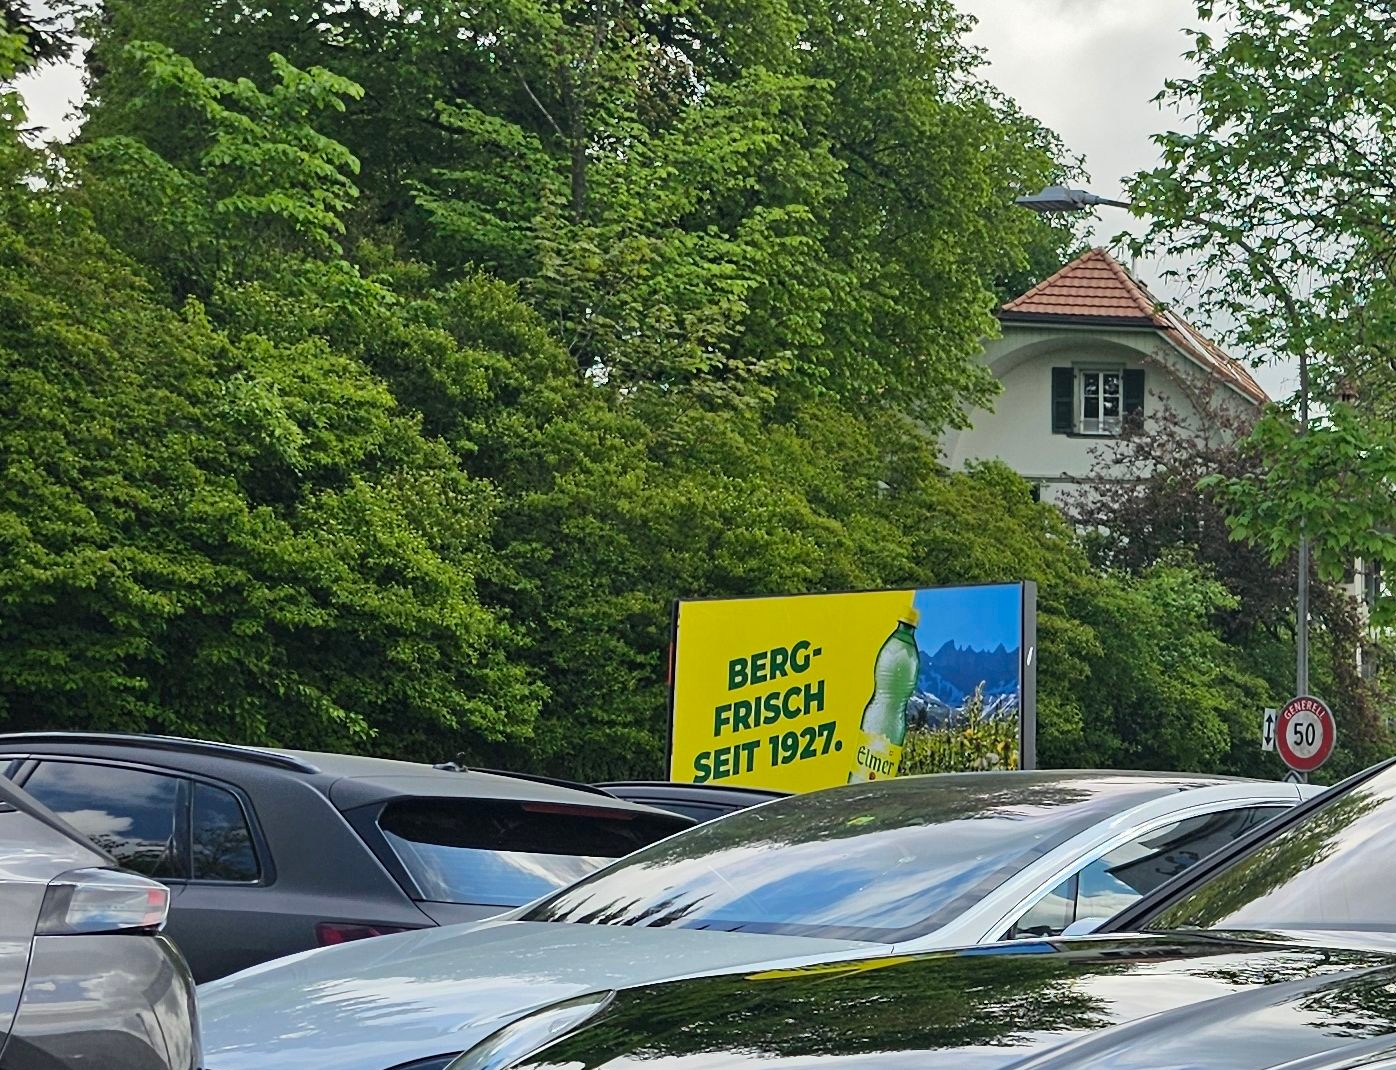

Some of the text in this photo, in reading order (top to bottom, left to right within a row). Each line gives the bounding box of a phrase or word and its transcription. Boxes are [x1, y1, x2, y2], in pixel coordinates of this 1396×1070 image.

[728, 640, 823, 691] BERG-
[714, 680, 825, 737] FRISCH
[1284, 700, 1325, 720] GENERELL
[693, 721, 843, 784] SEIT 1927.
[1294, 722, 1316, 747] 50
[857, 744, 895, 777] Elmer
